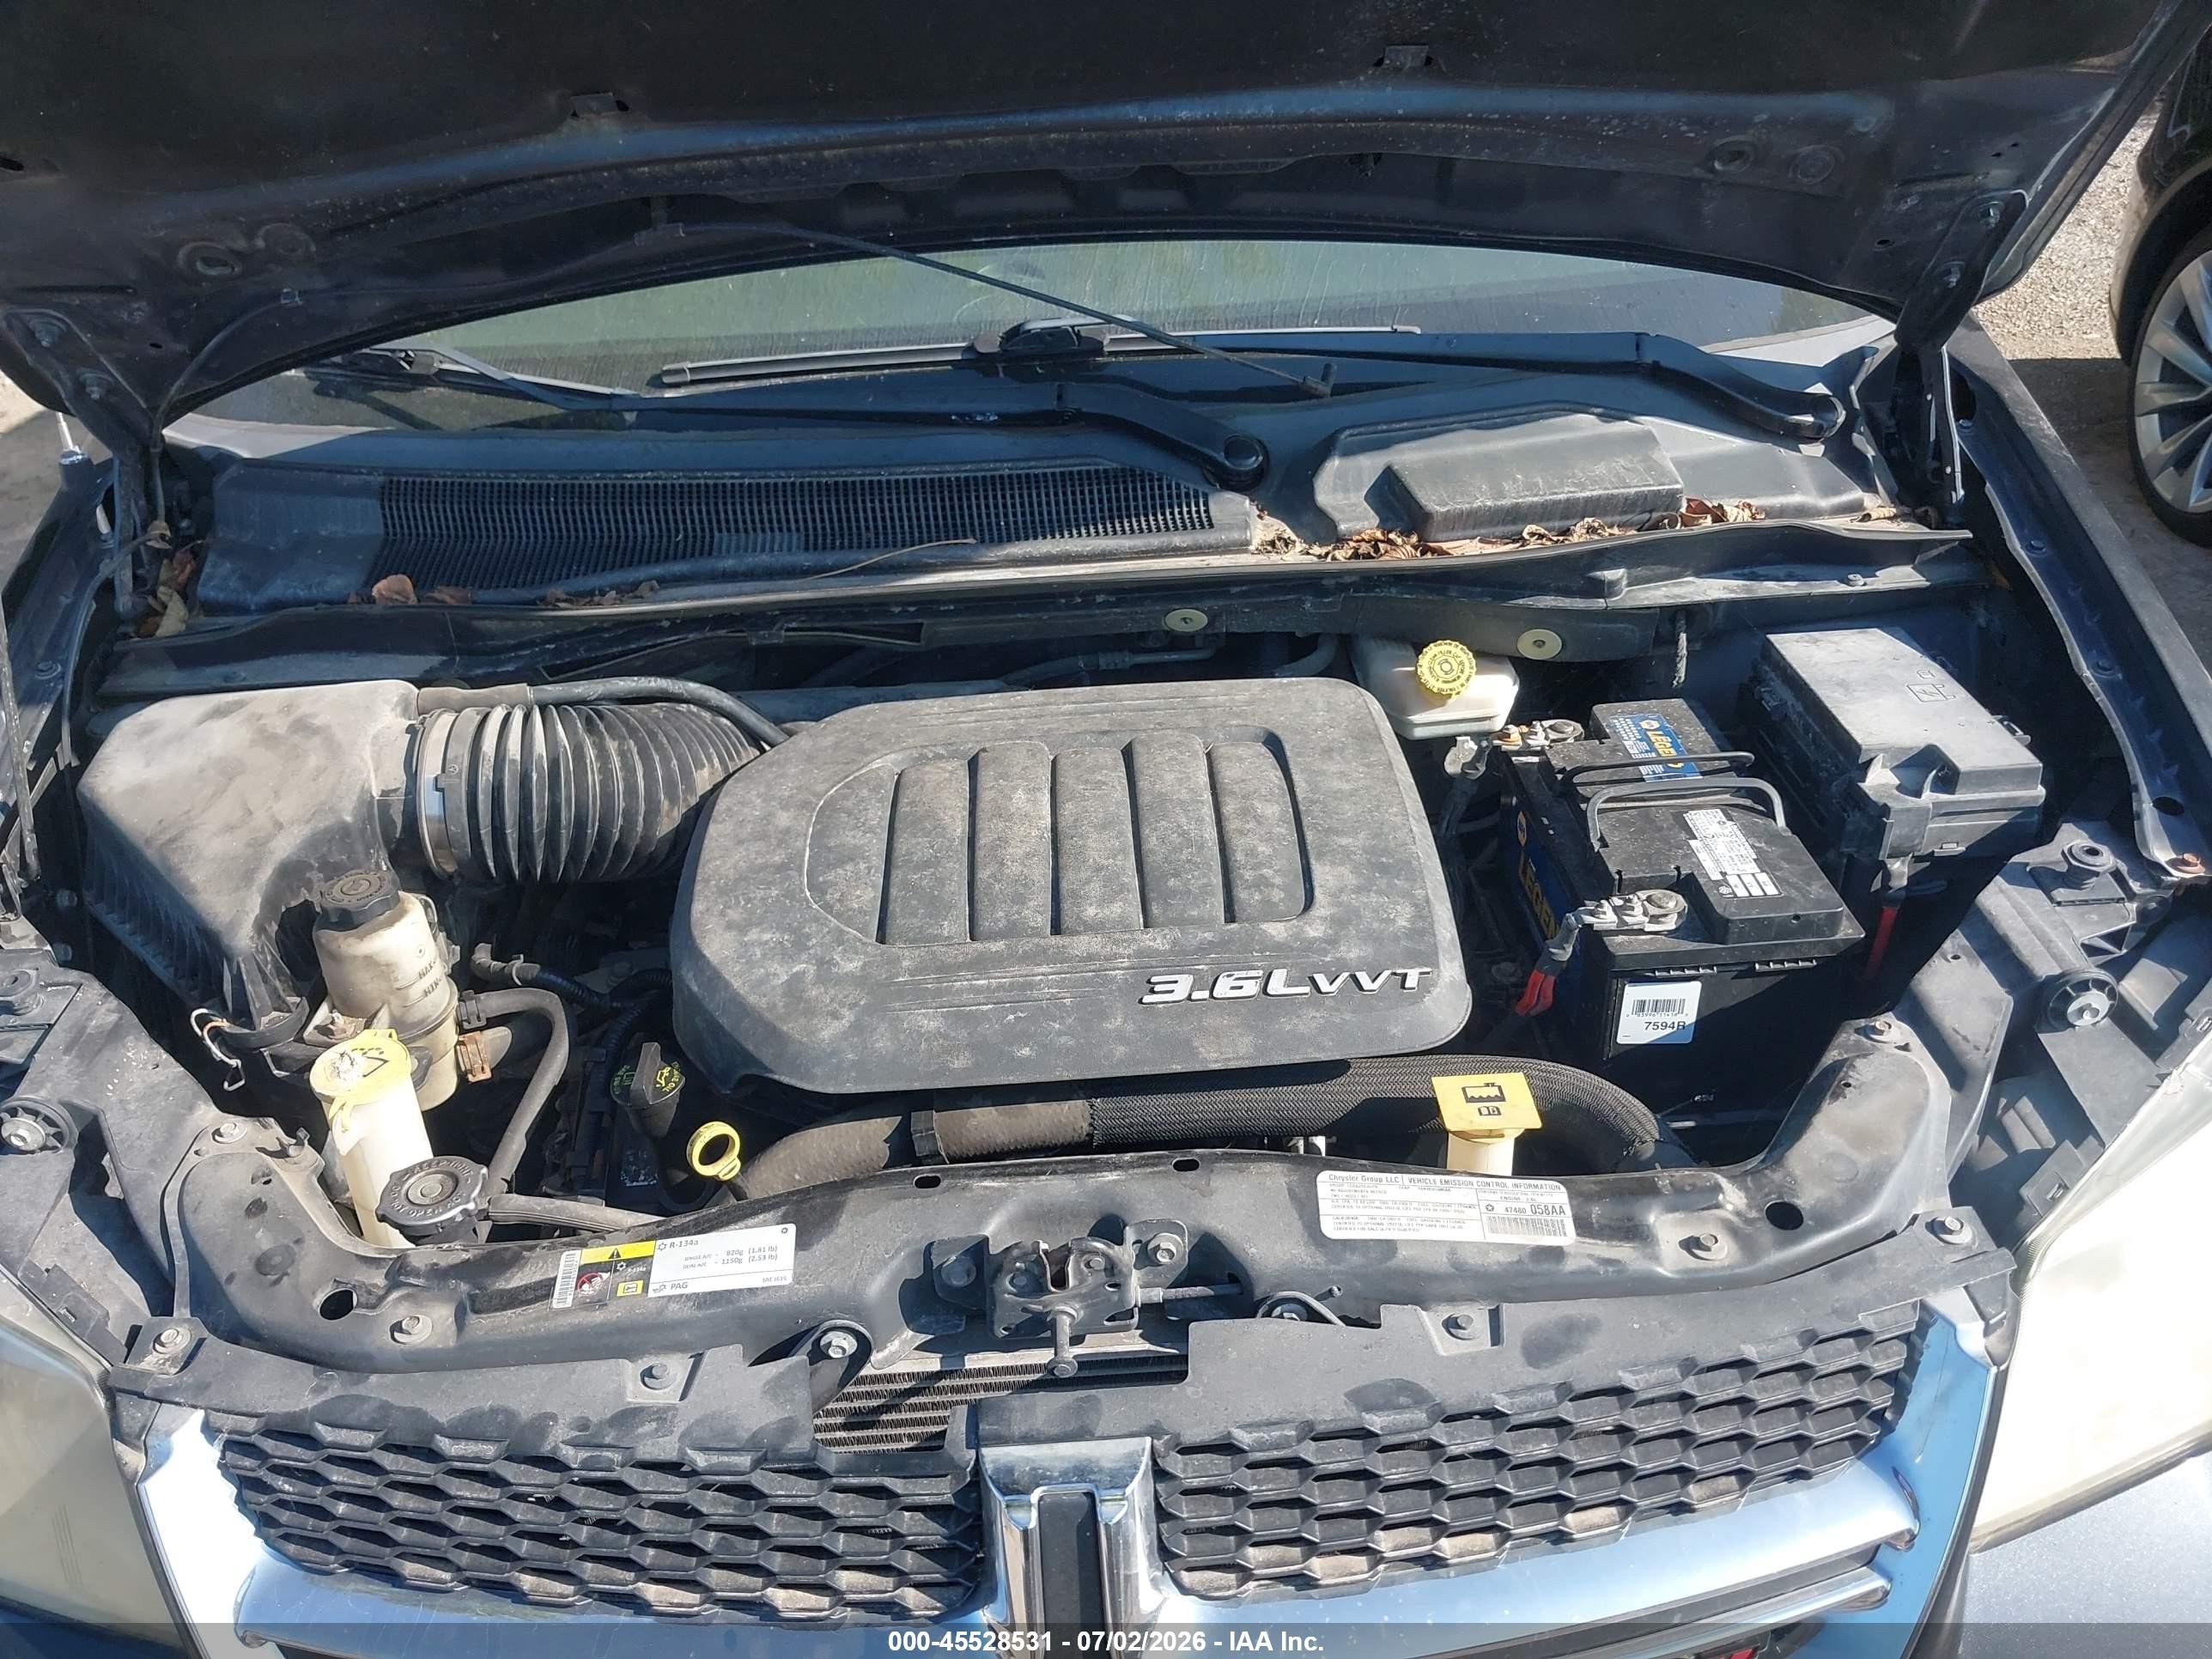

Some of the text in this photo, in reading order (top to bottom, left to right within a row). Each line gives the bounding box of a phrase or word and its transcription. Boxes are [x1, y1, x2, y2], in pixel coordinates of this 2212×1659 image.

[1139, 968, 1432, 1006] 3.6L VVT
[1644, 1021, 1686, 1031] 7594R
[1328, 1174, 1358, 1182] Chrysler
[1511, 1182, 1561, 1191] INFORMATION
[1530, 1204, 1566, 1215] 058AA
[669, 1239, 699, 1249] R-134a
[726, 1249, 744, 1257] 820g
[721, 1256, 744, 1265] 1150g
[671, 1282, 689, 1291] PAG
